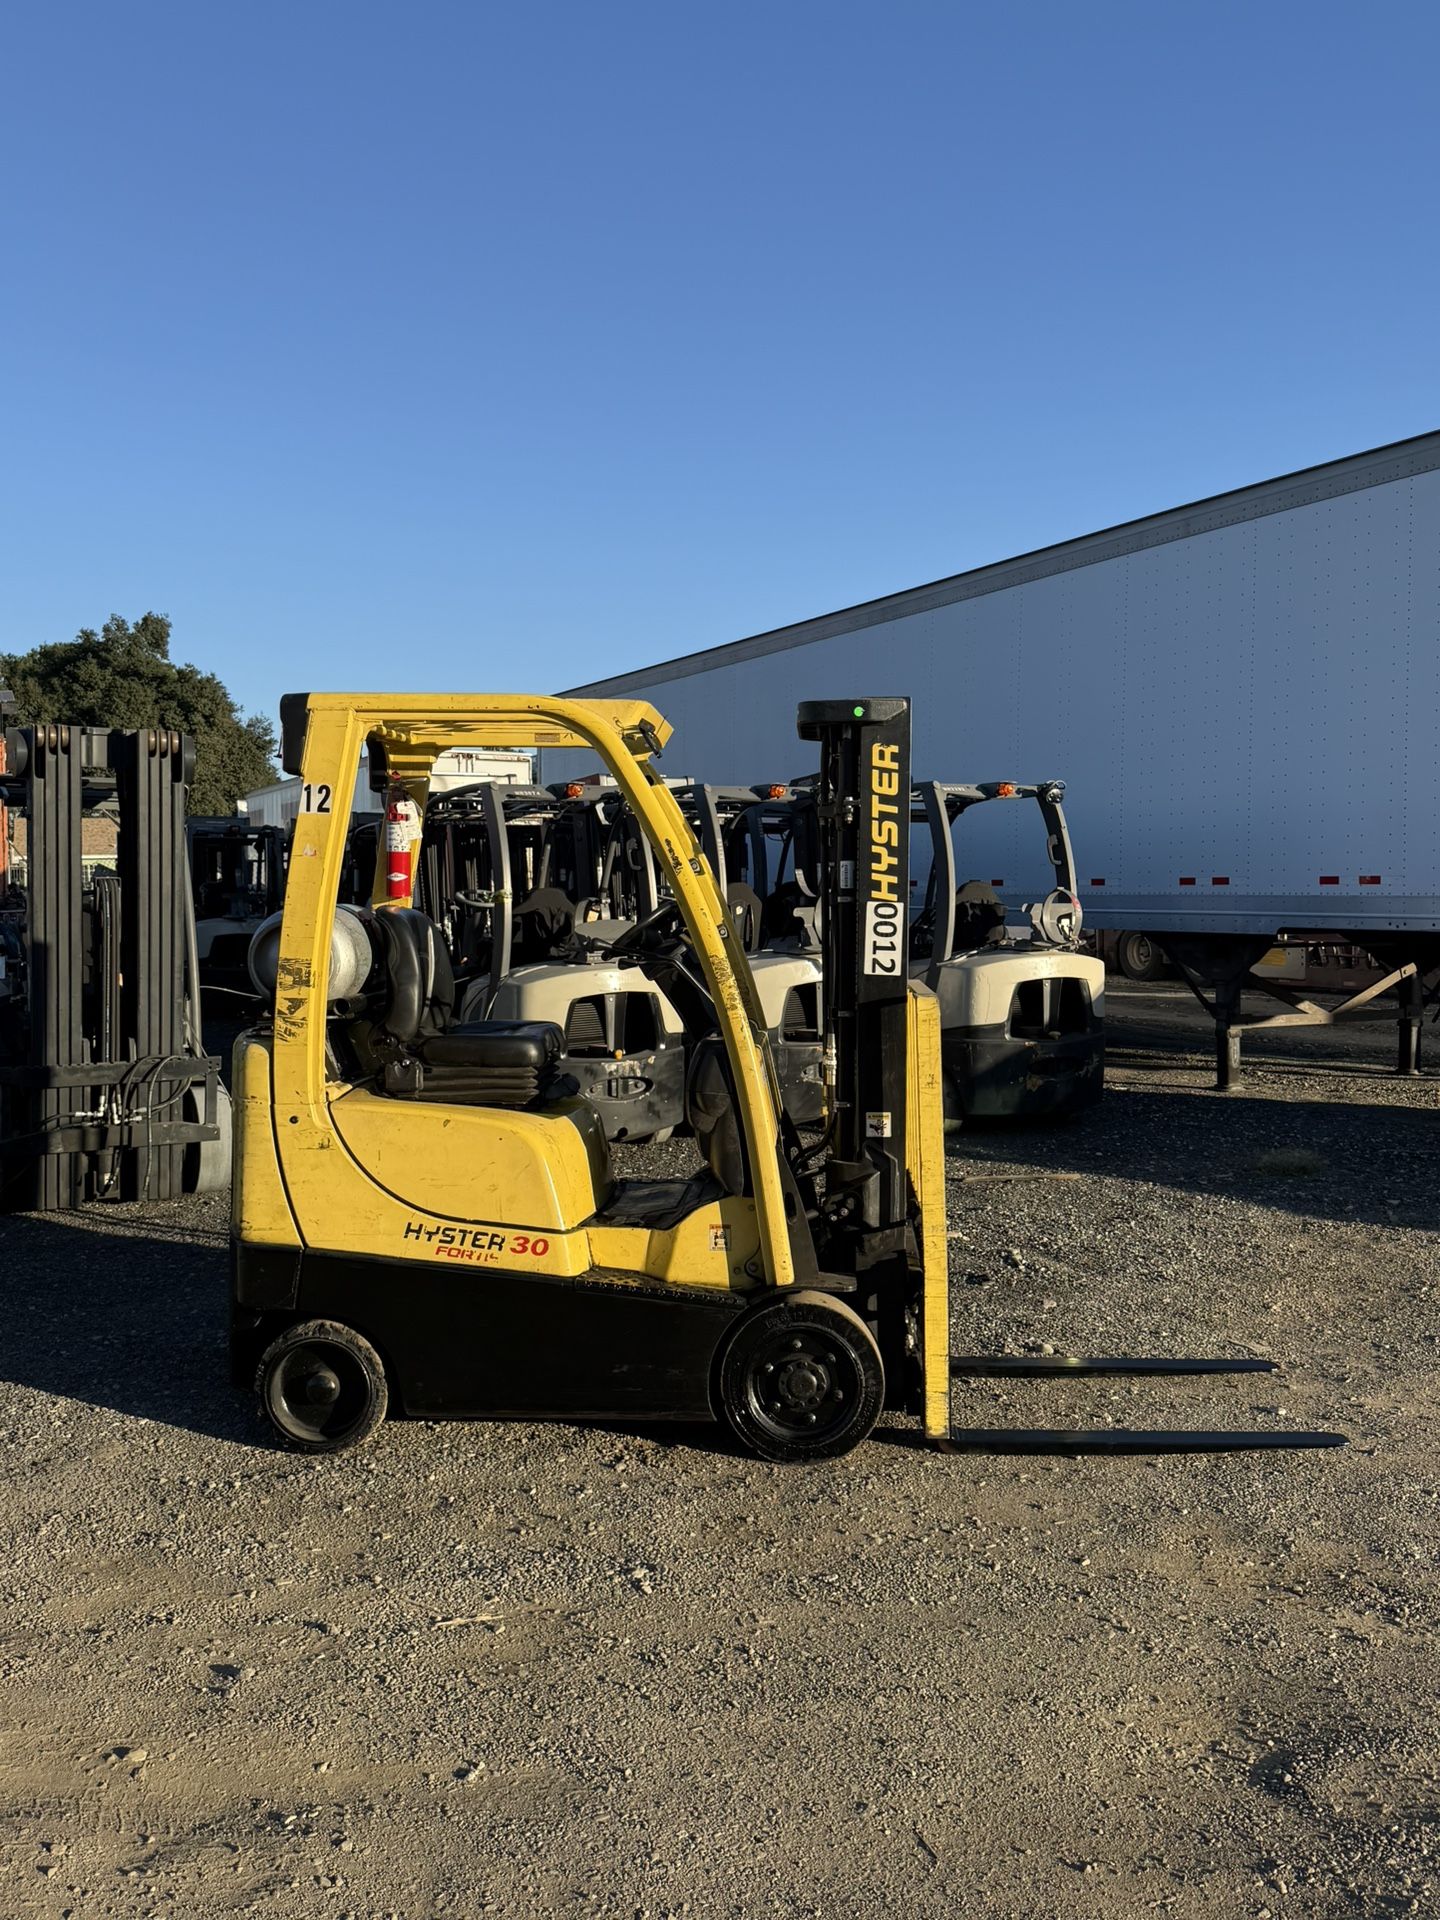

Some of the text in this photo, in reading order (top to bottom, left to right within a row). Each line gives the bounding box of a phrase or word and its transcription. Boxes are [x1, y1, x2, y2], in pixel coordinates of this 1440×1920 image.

[303, 783, 331, 813] 12
[871, 742, 900, 902] HYSTER
[871, 902, 899, 974] 0012
[403, 1222, 550, 1257] HYSTER 30
